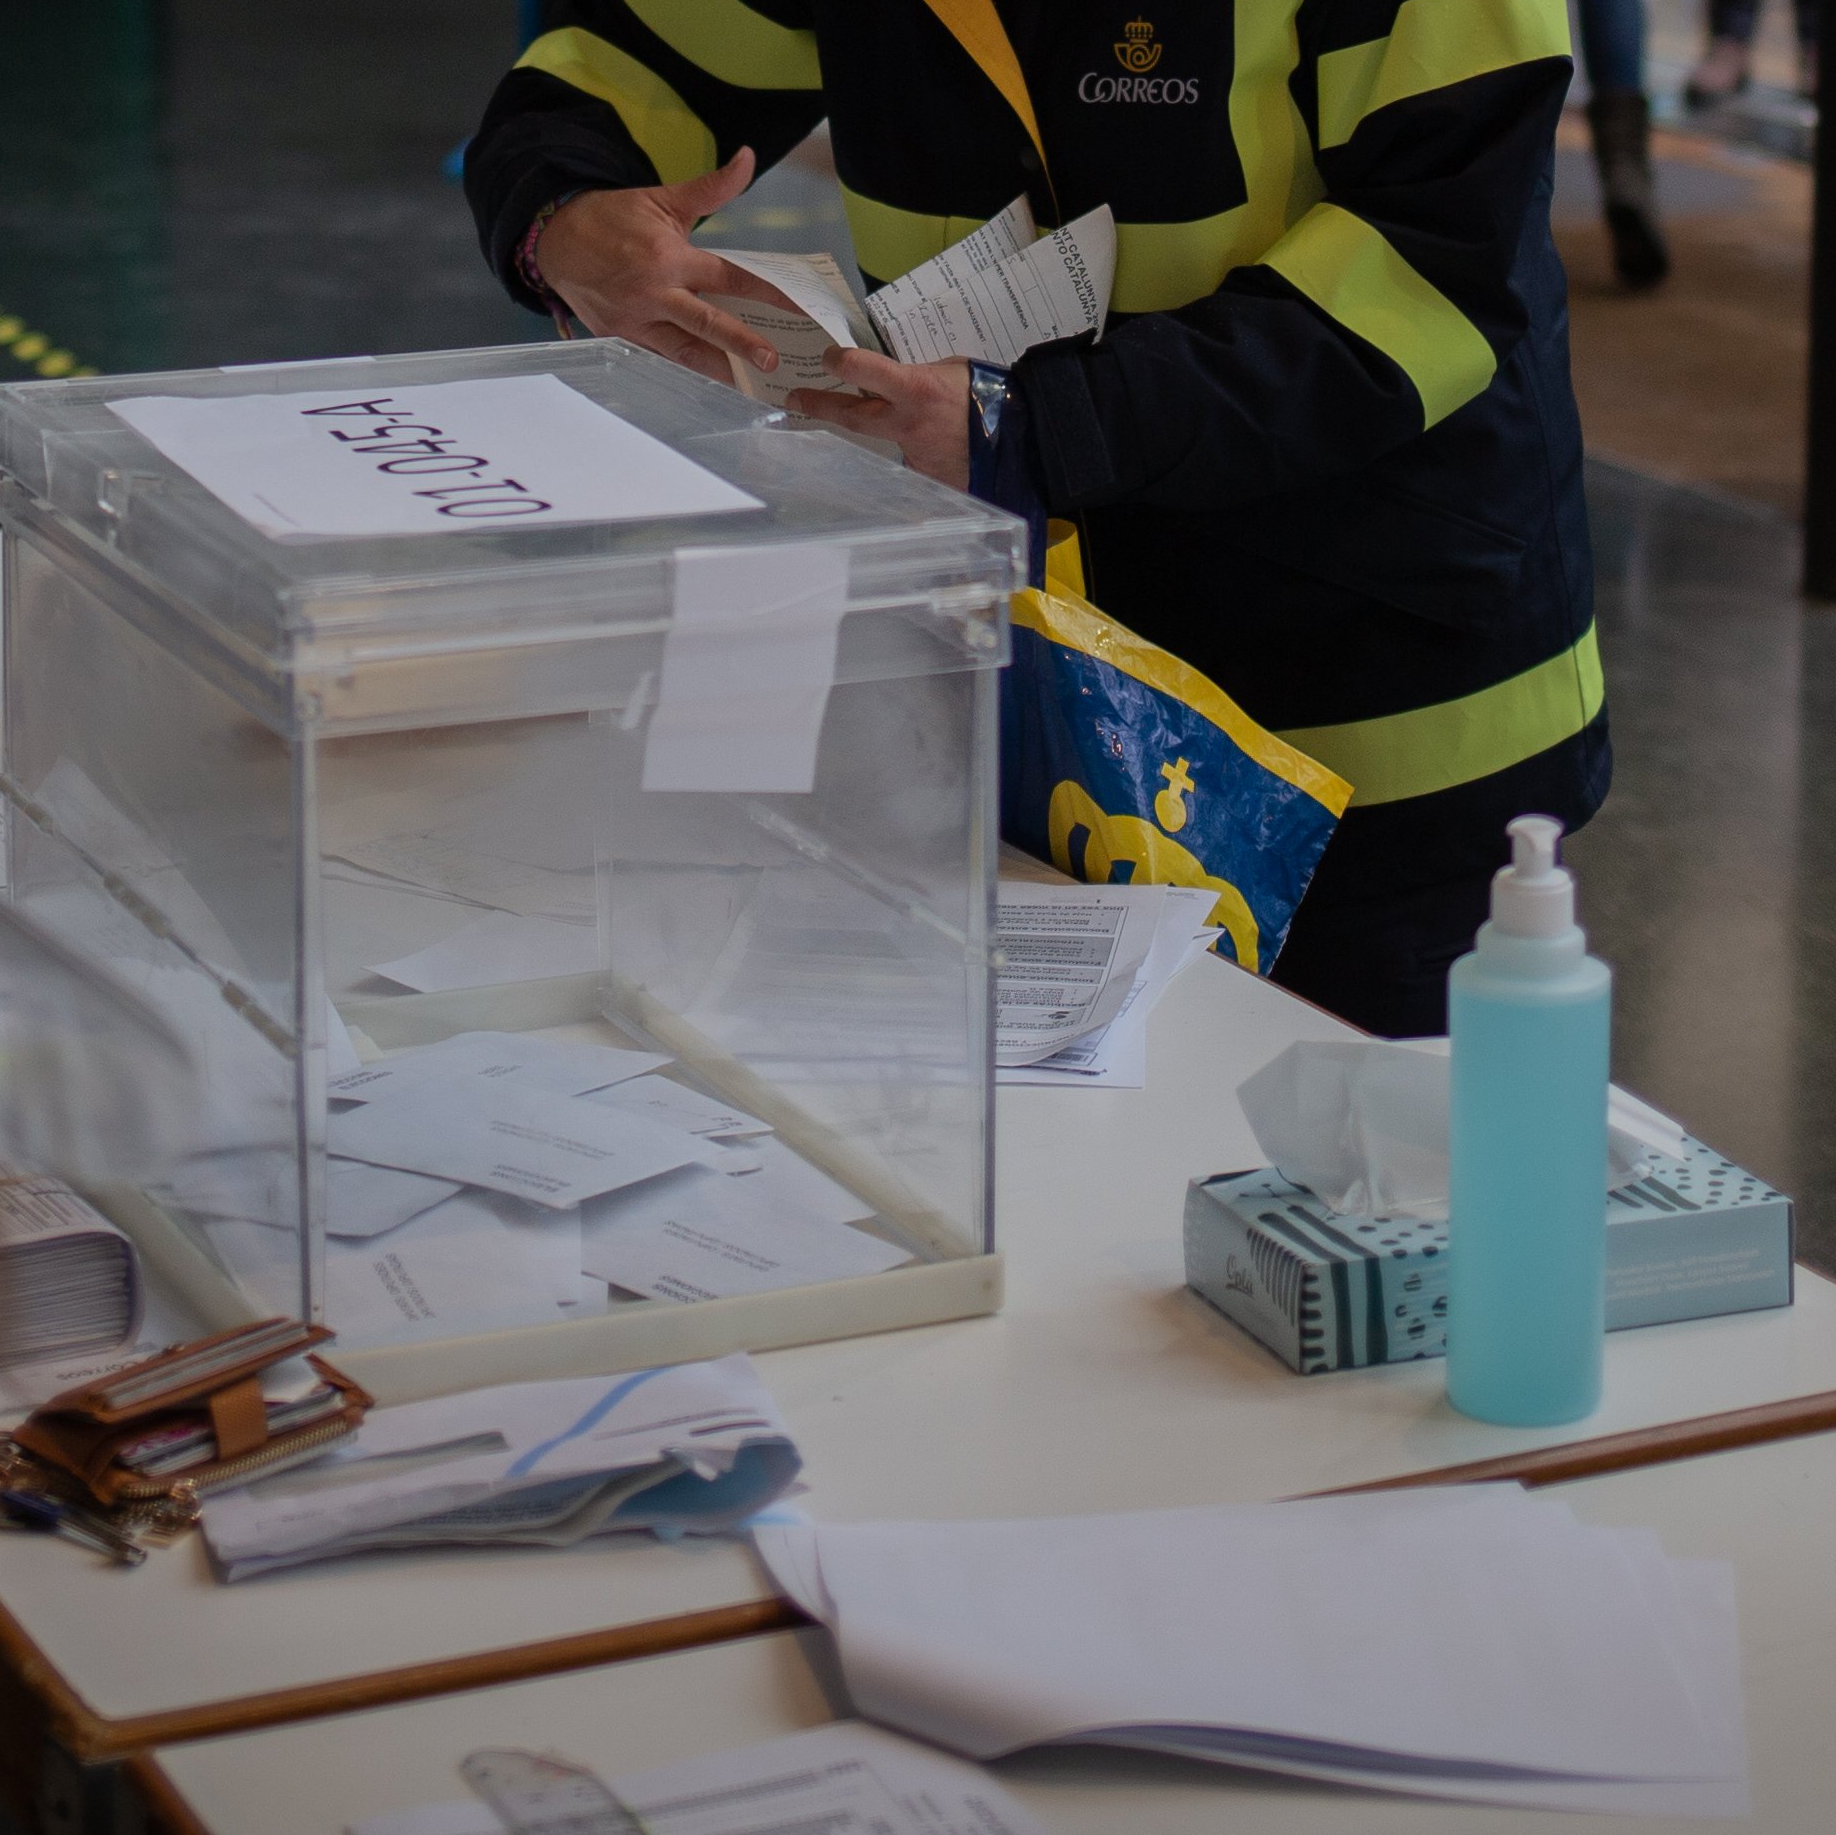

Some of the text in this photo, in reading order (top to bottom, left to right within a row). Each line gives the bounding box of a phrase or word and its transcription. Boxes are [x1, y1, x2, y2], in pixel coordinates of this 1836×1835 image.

[1077, 71, 1200, 106] CORREOS
[1061, 255, 1094, 324] CATALUNYA
[1066, 243, 1100, 312] CATALUNYA
[301, 397, 553, 519] 01-045-A
